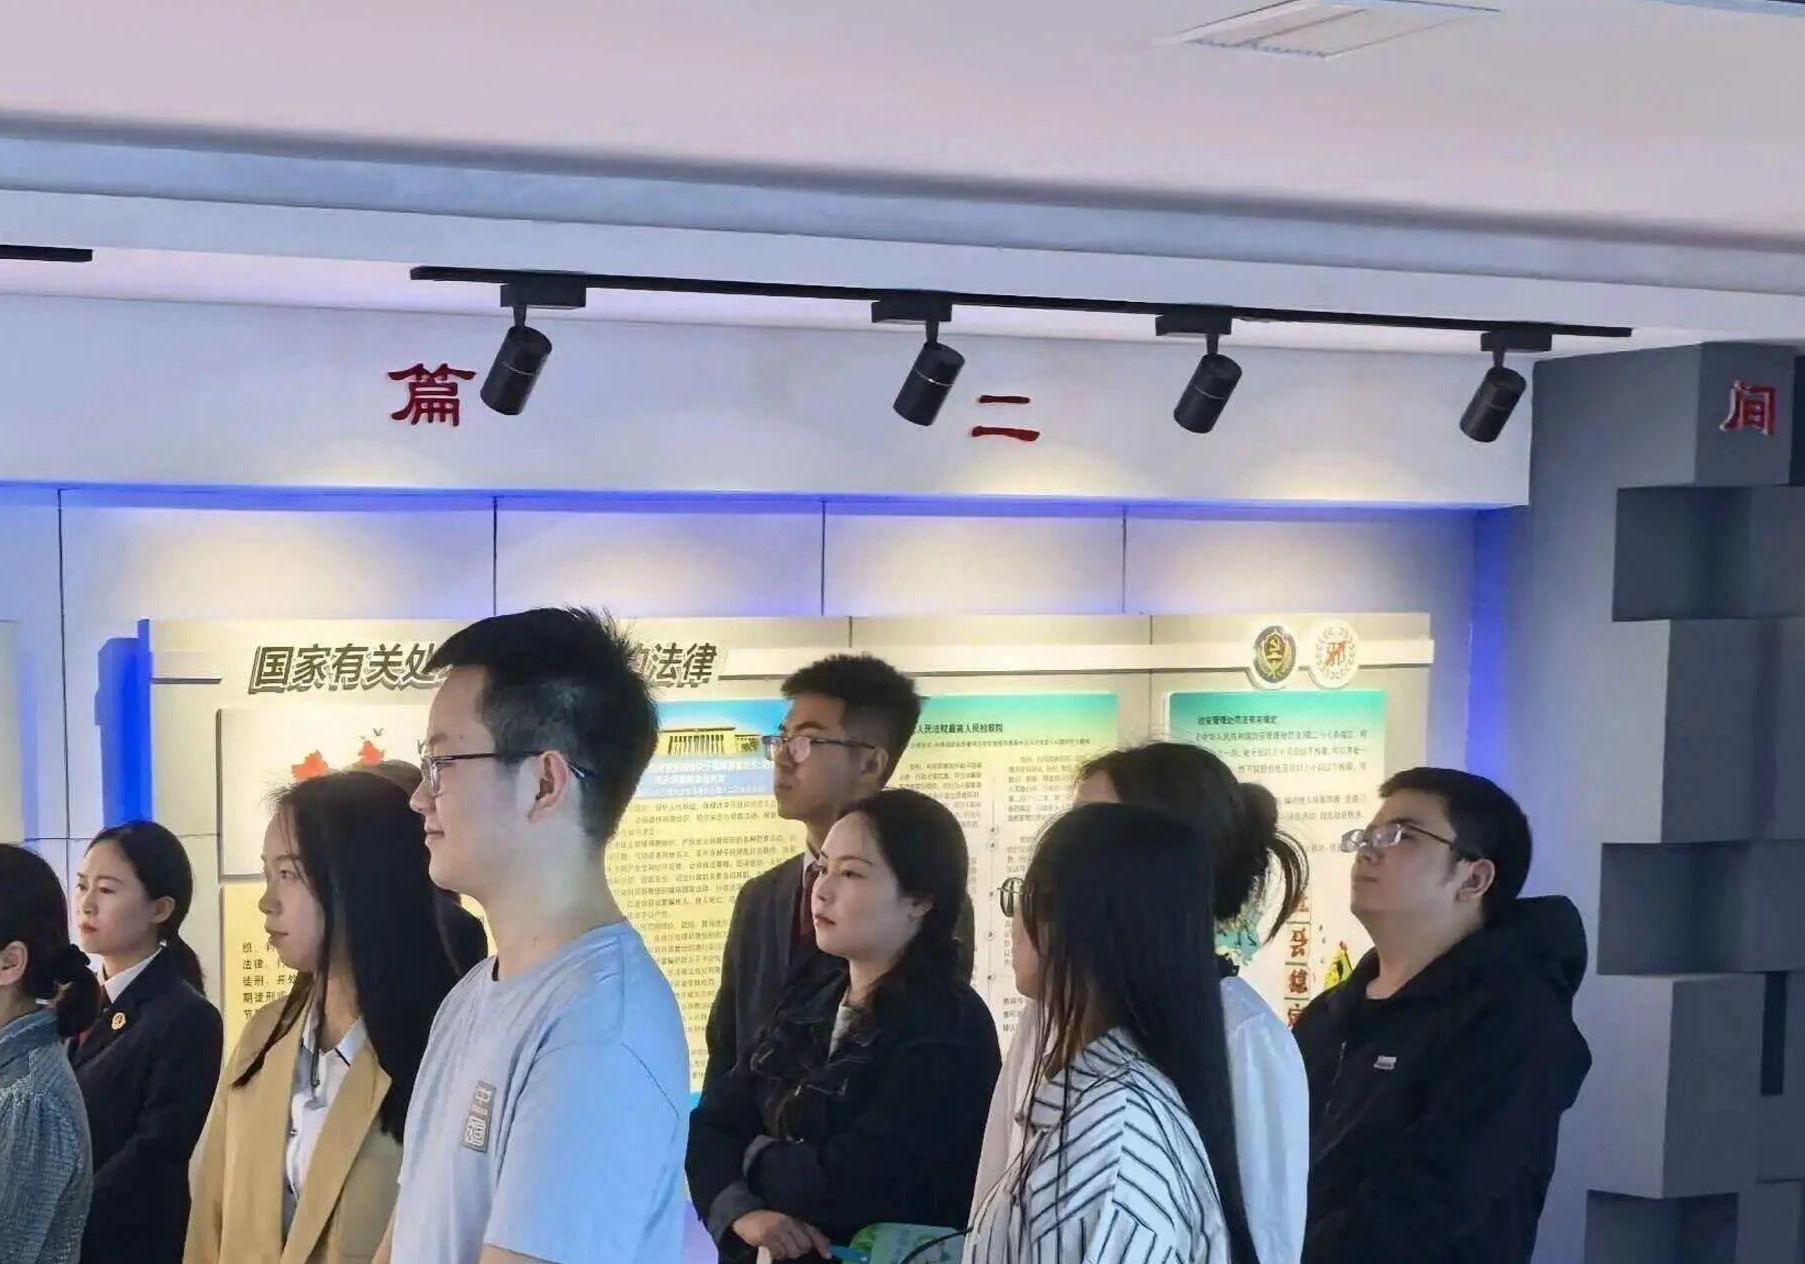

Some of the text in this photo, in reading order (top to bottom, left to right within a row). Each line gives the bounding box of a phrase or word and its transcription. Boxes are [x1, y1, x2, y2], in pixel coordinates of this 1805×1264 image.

[388, 363, 476, 426] 篇
[973, 394, 1038, 444] 二
[1720, 381, 1777, 435] 间
[914, 722, 1003, 734] 人民法院最高人民检察院
